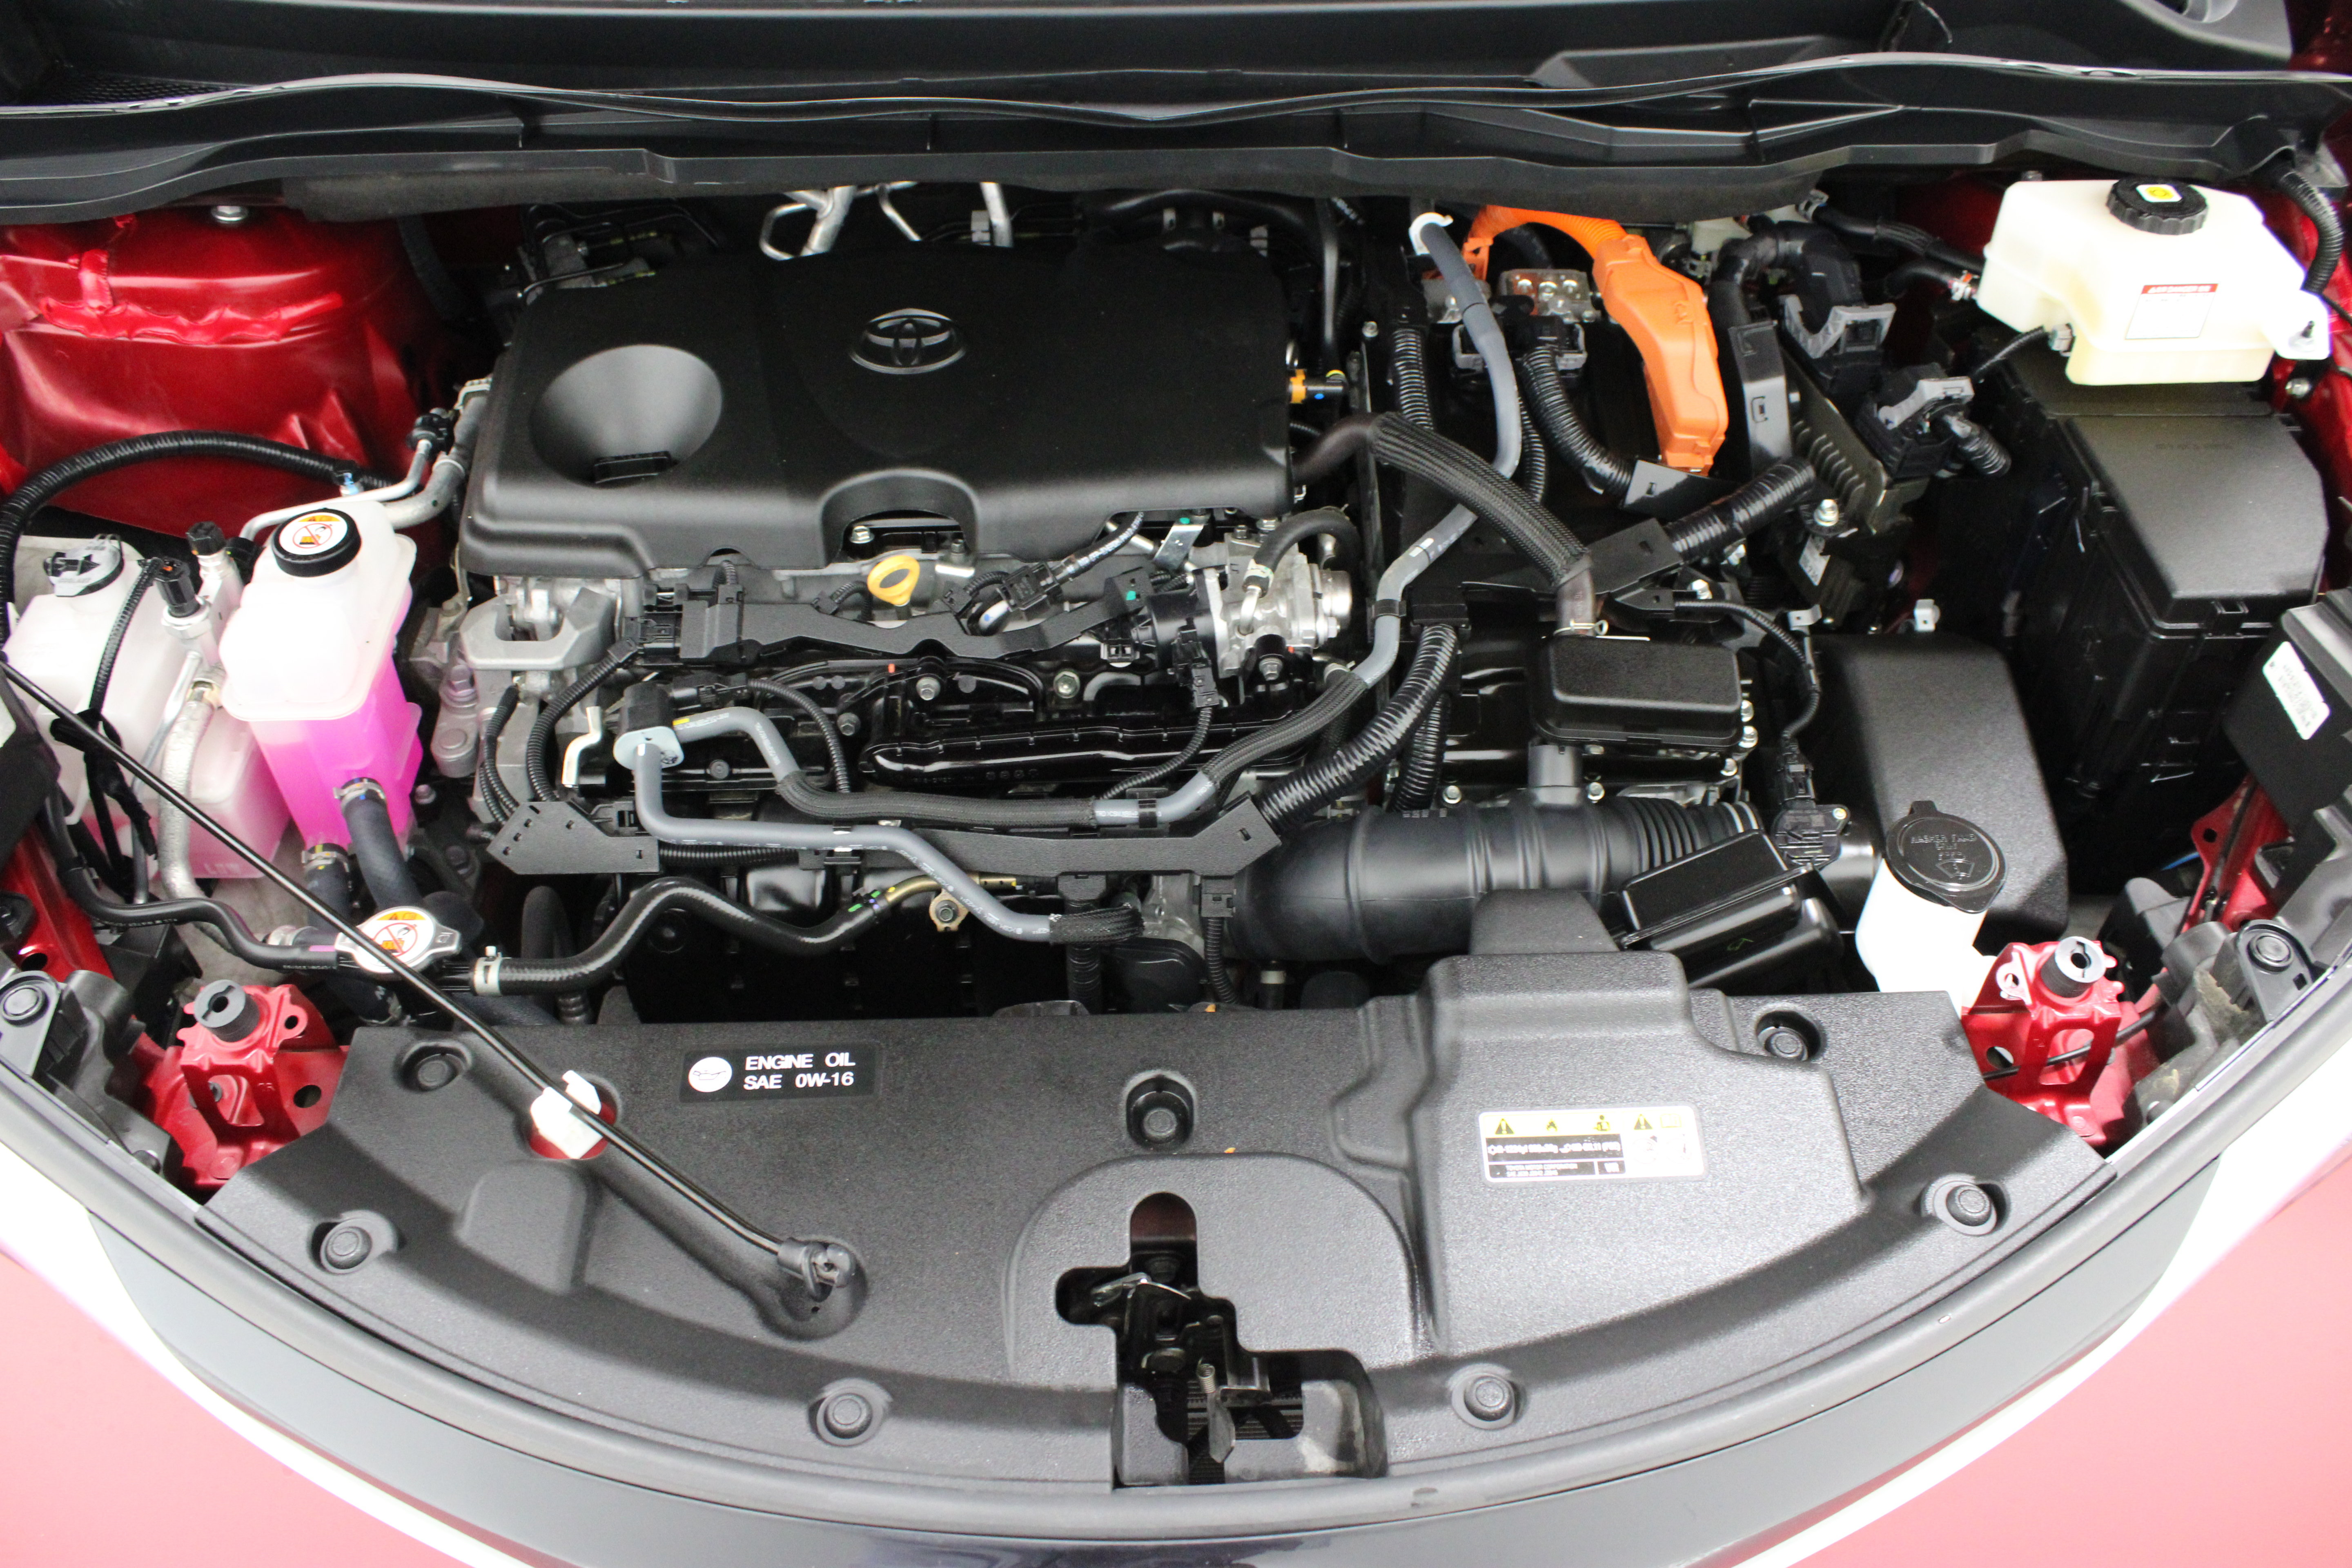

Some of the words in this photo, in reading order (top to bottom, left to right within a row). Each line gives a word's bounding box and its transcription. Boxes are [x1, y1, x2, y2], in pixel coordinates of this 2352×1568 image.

[745, 1054, 813, 1070] ENGINE
[825, 1052, 856, 1067] OIL
[743, 1074, 782, 1090] SAE
[795, 1071, 854, 1088] 0W-16
